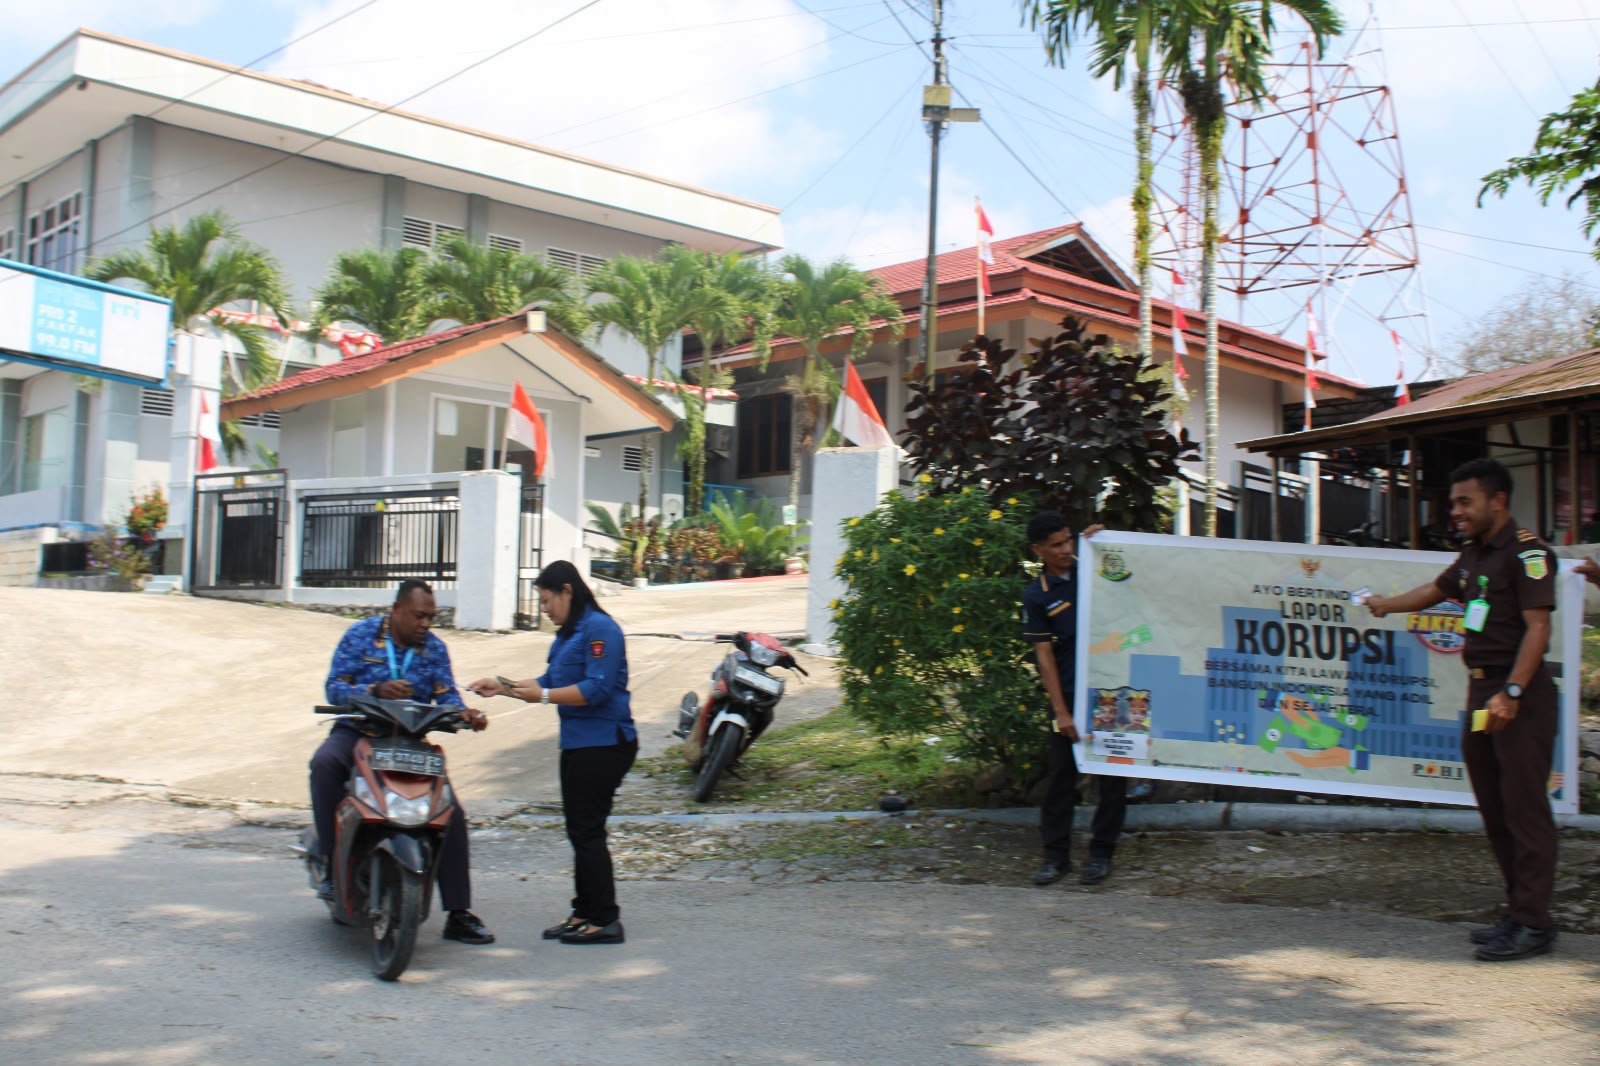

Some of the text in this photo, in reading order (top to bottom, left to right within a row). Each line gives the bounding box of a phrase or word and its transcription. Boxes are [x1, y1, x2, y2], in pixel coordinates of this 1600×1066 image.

[1252, 584, 1351, 601] AYO BERTIND
[1280, 600, 1345, 622] LAPOR
[1235, 618, 1396, 666] KORUPSI
[1205, 660, 1271, 675] BERSAMA
[1275, 665, 1306, 677] KITA
[1310, 668, 1366, 682] LAWAN
[1208, 678, 1269, 691] BANGUN
[1272, 682, 1348, 696] INDONESIA
[1353, 688, 1397, 701] YANG
